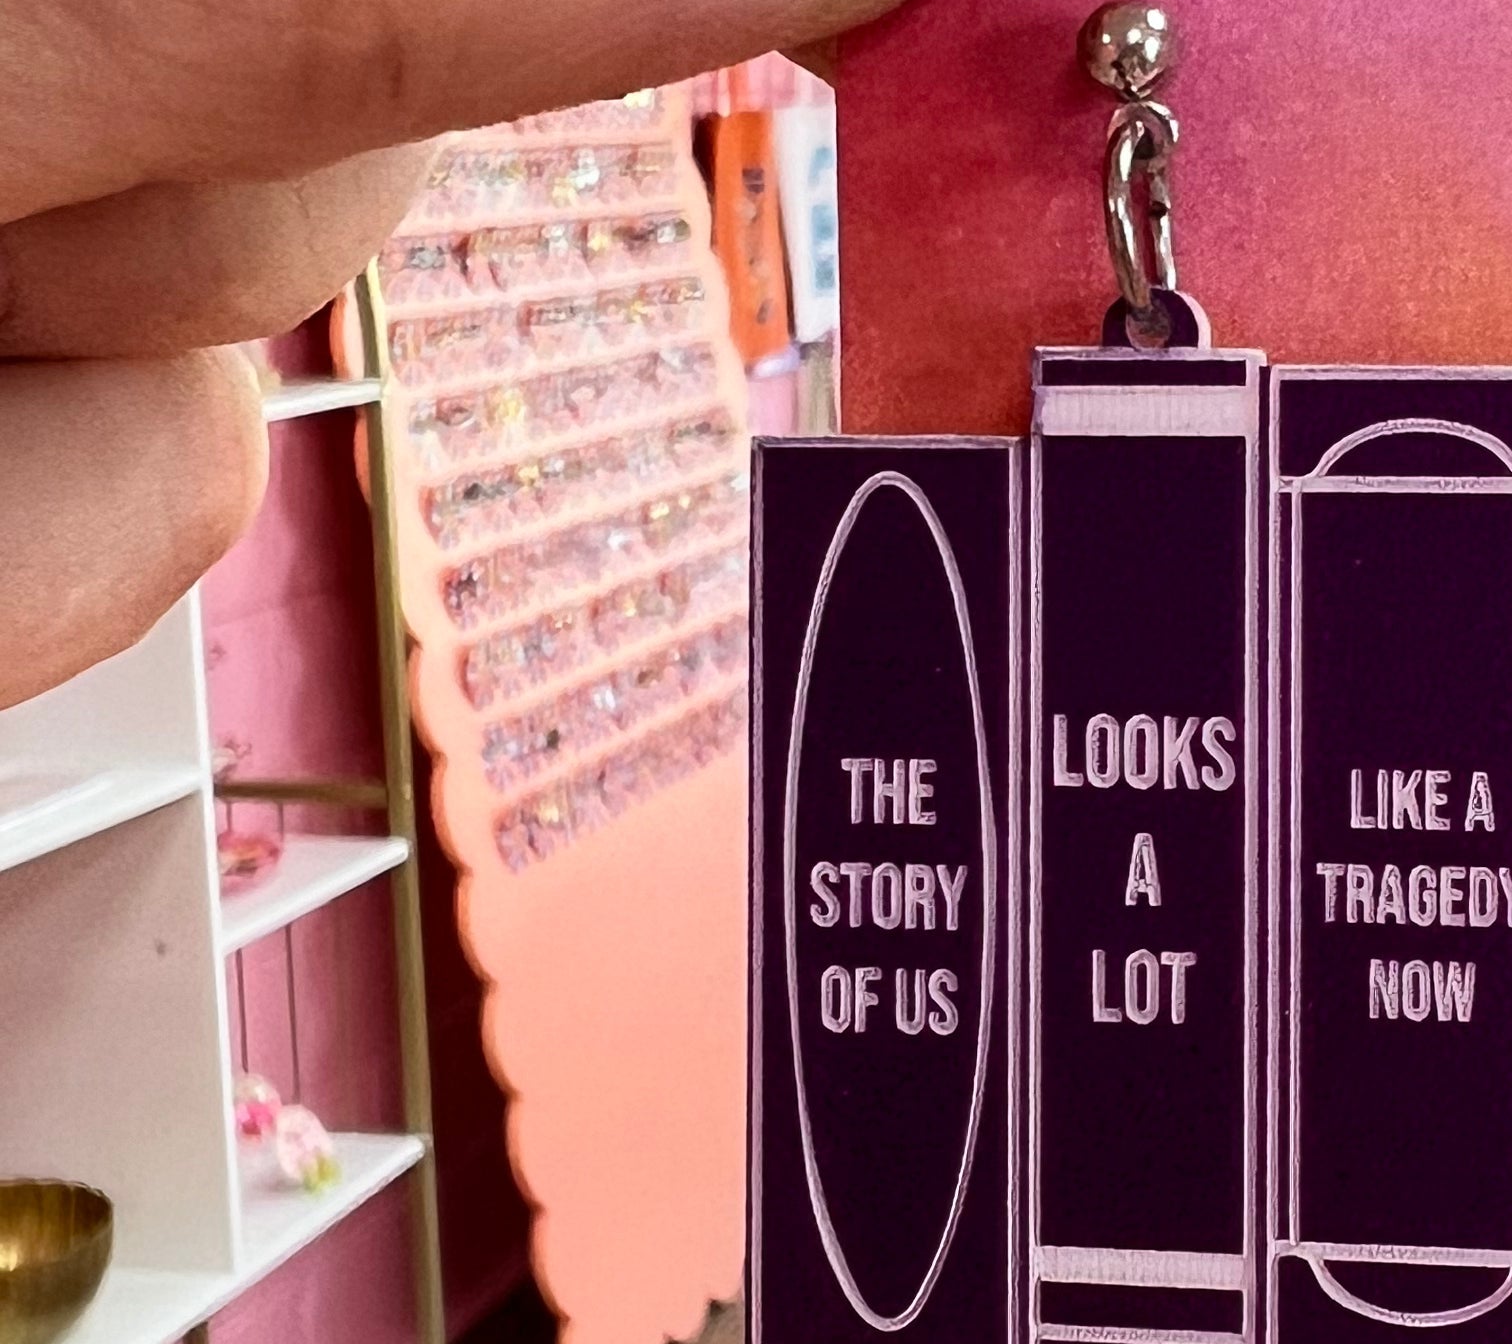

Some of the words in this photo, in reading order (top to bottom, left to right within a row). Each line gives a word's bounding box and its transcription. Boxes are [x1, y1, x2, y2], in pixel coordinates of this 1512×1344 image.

[1052, 712, 1237, 792] LOOKS
[840, 757, 938, 826] THE
[1350, 768, 1452, 831] LIKE
[1464, 771, 1496, 832] A
[809, 861, 966, 931] STORY
[1124, 832, 1162, 907] A
[820, 964, 882, 1034] OF
[895, 967, 959, 1036] US
[1091, 948, 1197, 1025] LOT
[1368, 958, 1476, 1023] NOW
